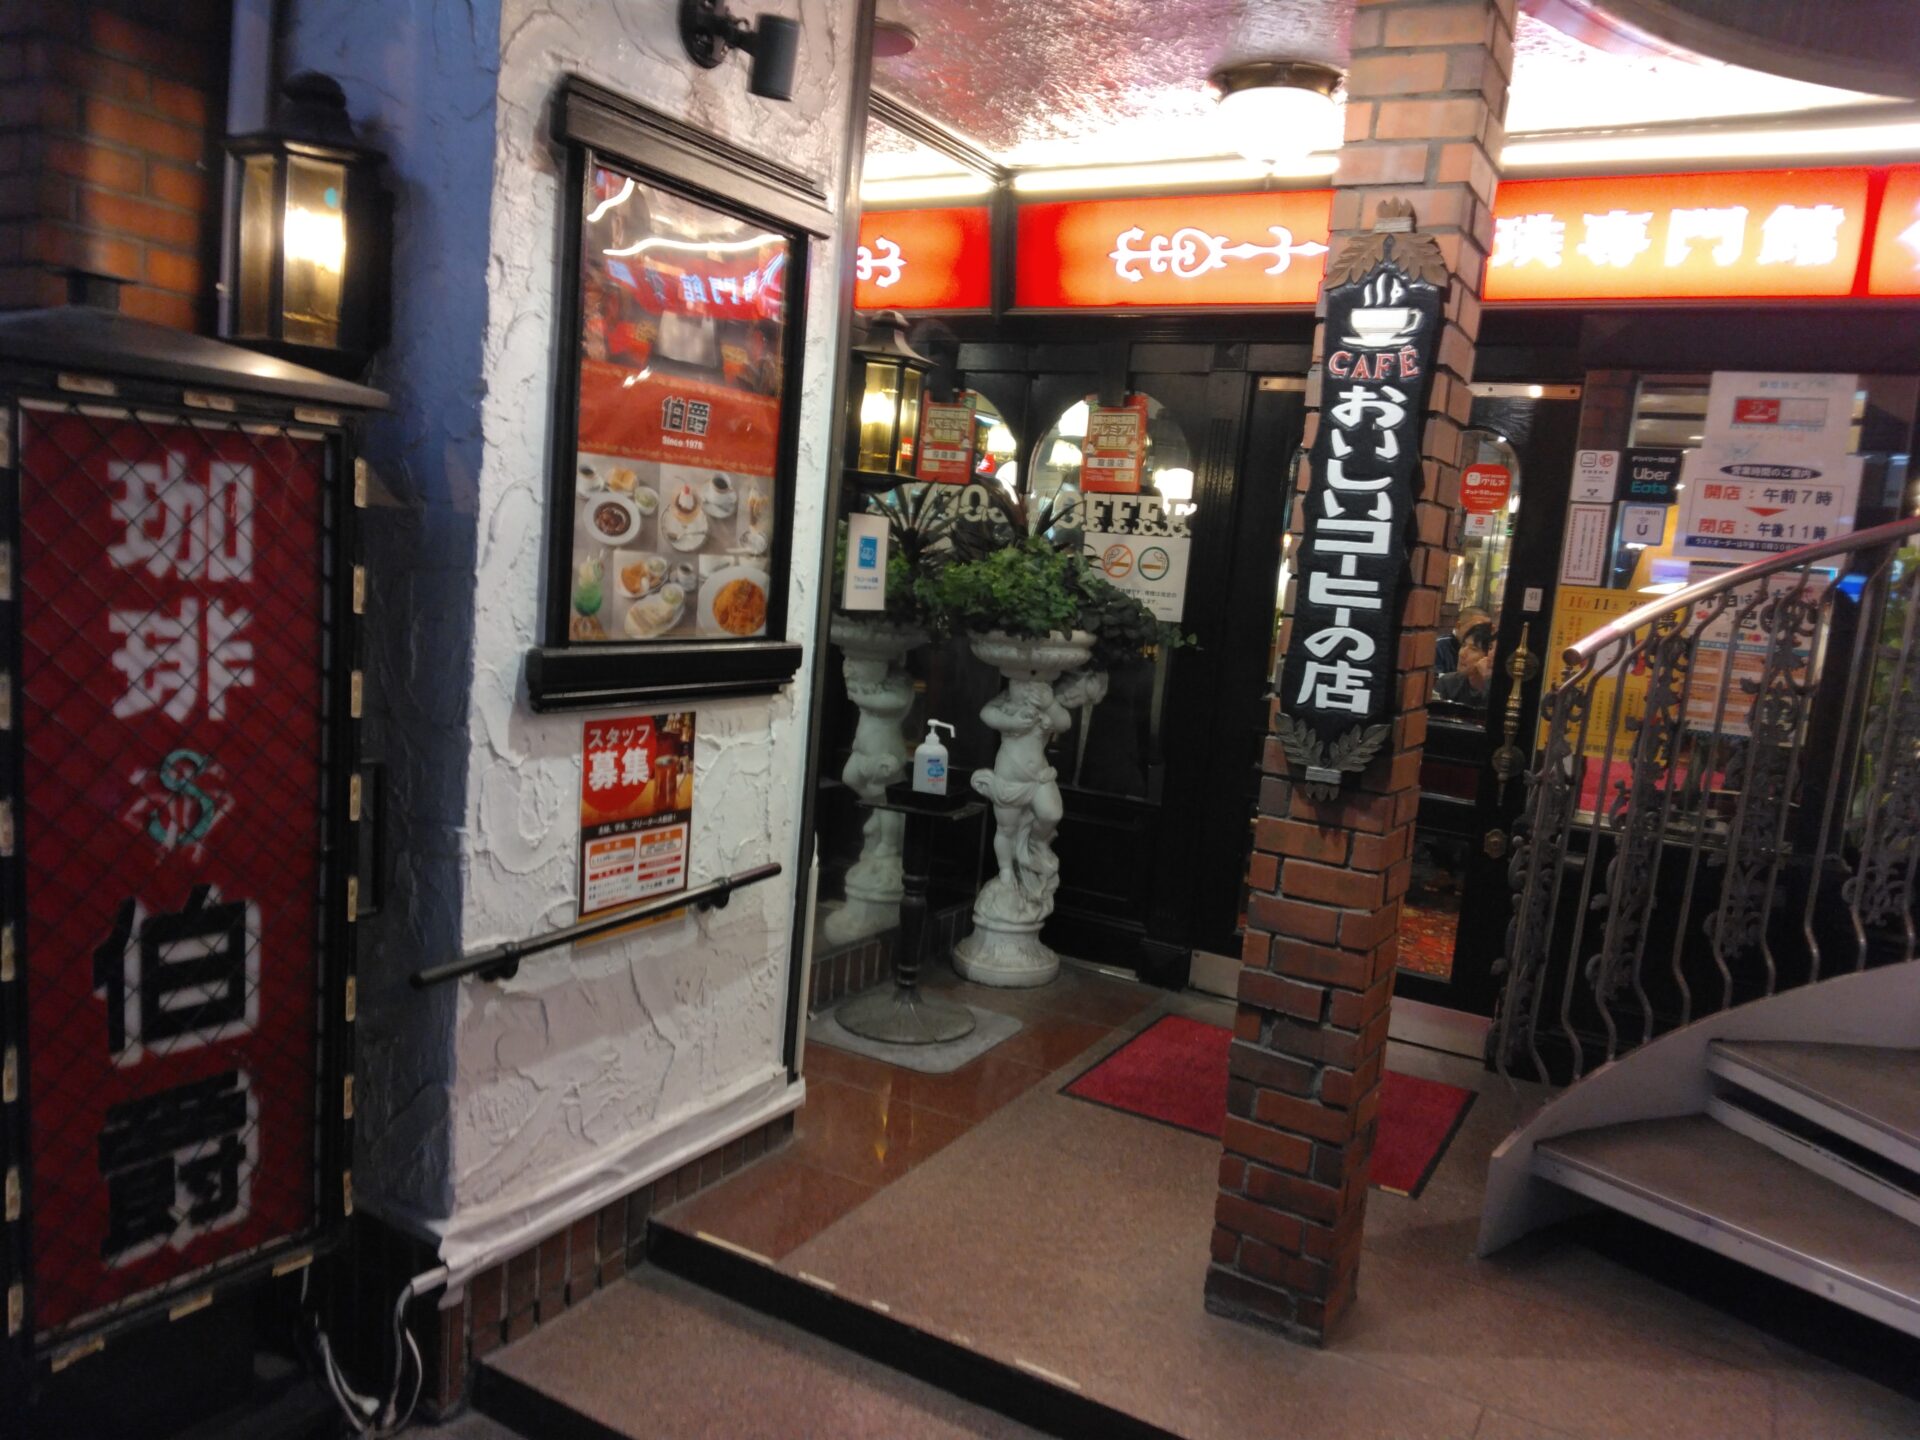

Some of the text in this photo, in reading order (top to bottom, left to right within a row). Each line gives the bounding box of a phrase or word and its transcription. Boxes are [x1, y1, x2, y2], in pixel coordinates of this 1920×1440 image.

[1631, 481, 1668, 494] Eats
[1633, 467, 1671, 480] Uber
[1297, 384, 1409, 715] おいしいコーヒーの店
[108, 453, 254, 721] 珈琲
[588, 724, 650, 749] スタッフ
[588, 747, 649, 792] 募集
